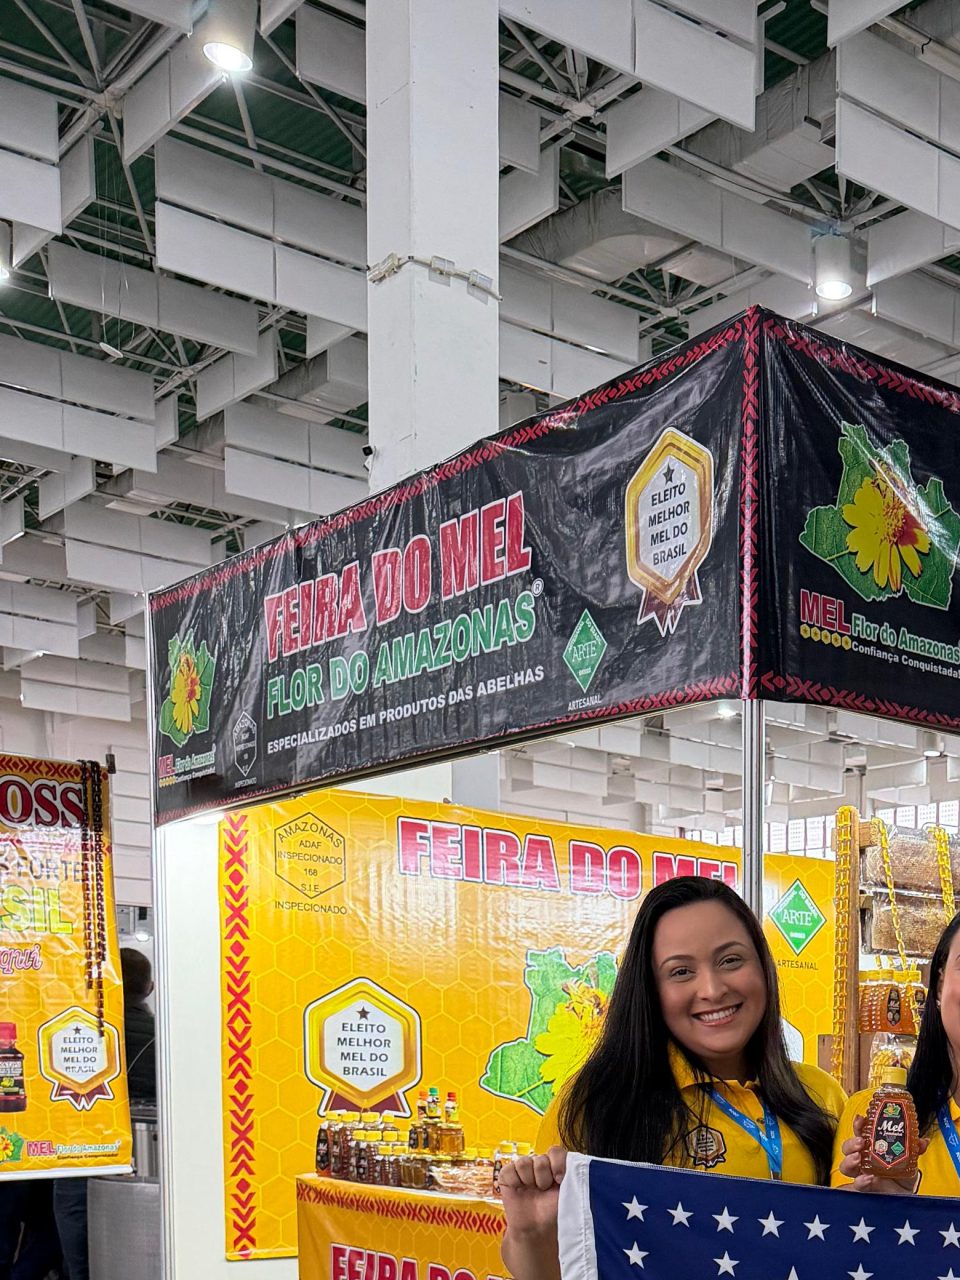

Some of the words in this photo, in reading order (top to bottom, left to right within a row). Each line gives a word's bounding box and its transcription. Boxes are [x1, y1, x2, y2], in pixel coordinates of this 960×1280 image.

[651, 482, 686, 507] ELEITO
[648, 500, 690, 528] MELHOR
[650, 531, 671, 546] MEL
[673, 522, 688, 538] DO
[653, 548, 687, 565] BRASIL
[264, 560, 368, 664] FEIRA
[372, 534, 432, 626] DO
[439, 490, 533, 601] MEL
[800, 588, 851, 635] MEL
[851, 613, 879, 642] Flor
[880, 622, 897, 647] do
[572, 640, 598, 662] ARTE
[851, 641, 900, 664] Confiança
[901, 655, 960, 679] Conquistada!
[267, 663, 325, 720] FLOR
[330, 651, 370, 701] DO
[267, 716, 357, 754] ESPECIALIZADOS
[359, 713, 376, 730] EM
[379, 694, 446, 724] PRODUTOS
[449, 685, 473, 704] DAS
[476, 665, 545, 697] ABELHAS
[277, 821, 342, 848] AMAZONAS
[299, 840, 322, 849] ADAF
[277, 851, 343, 865] INSPECIONADO
[398, 816, 561, 892] FEIRA
[568, 839, 643, 901] DO
[0, 885, 73, 934] SIL
[275, 901, 348, 915] INSPECIONADO
[781, 909, 812, 926] ARTE
[777, 959, 819, 970] ARTESANAL
[342, 1022, 386, 1034] ELEITO
[63, 1036, 94, 1044] ELEITO
[337, 1037, 392, 1048] MELHOR
[60, 1046, 98, 1054] MELHOR
[340, 1052, 366, 1062] MEL
[369, 1052, 389, 1062] DO
[343, 1066, 388, 1077] BRASIL
[877, 1120, 905, 1133] Mel
[26, 1141, 56, 1157] MEL
